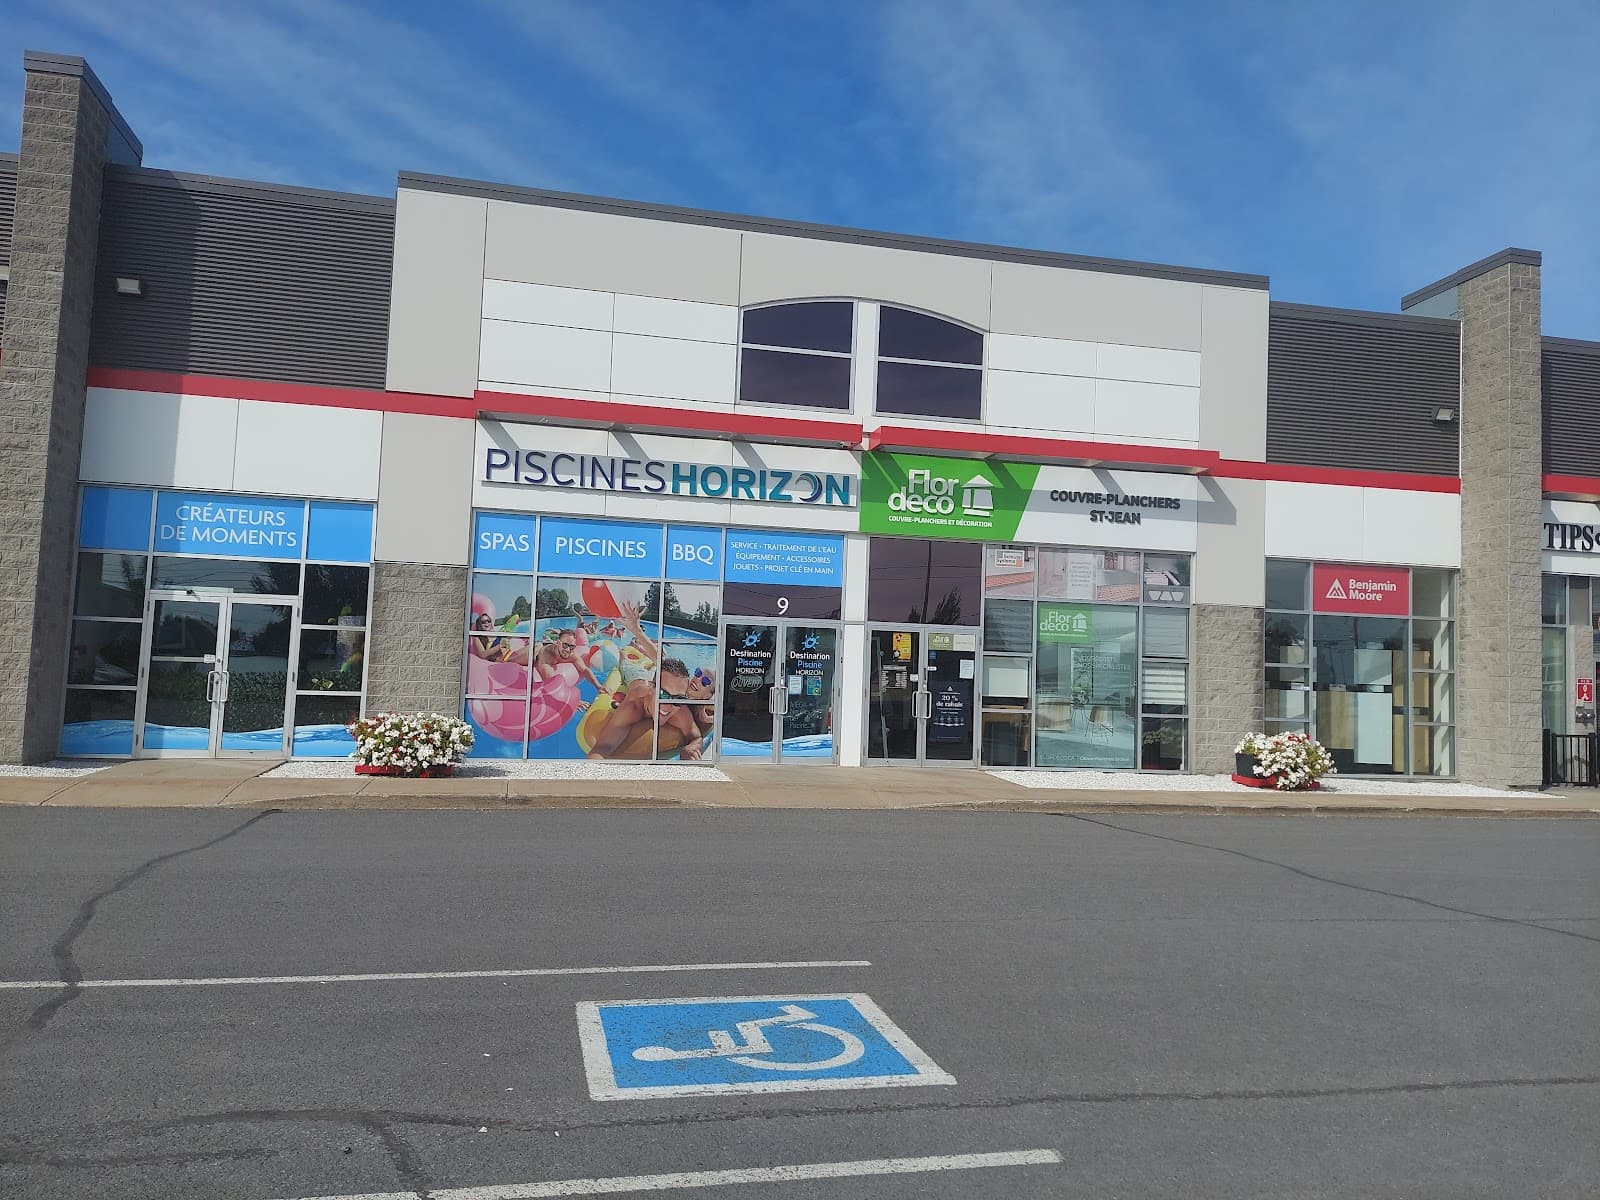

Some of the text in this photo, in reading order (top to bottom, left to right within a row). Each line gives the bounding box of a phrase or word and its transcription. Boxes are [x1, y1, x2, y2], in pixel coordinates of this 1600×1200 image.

[485, 447, 851, 505] PISCINES HORIZON
[908, 469, 959, 496] Flor
[887, 486, 955, 514] deco
[1050, 490, 1181, 509] COUVRE-PLANCHERS
[175, 502, 286, 527] CRÉATEURS
[1089, 509, 1141, 525] ST-JEAN
[160, 524, 297, 547] DE MOMENTS
[479, 532, 531, 552] SPAS
[1543, 522, 1600, 551] TIPS
[555, 537, 647, 559] PISCINES
[672, 543, 714, 565] BBQ
[731, 541, 758, 550] SERVICE
[763, 543, 806, 552] TRAITEMENT
[818, 546, 837, 554] L'EAU
[735, 551, 831, 564] ÉQUIPEMENT ACCESSOIRES
[733, 563, 759, 571] JOUETS
[764, 564, 788, 573] PROJET
[790, 565, 802, 573] CLÉ
[814, 567, 834, 575] MAIN
[1348, 579, 1397, 594] Benjamin
[1348, 590, 1383, 601] Moore
[777, 597, 789, 615] 9
[1048, 611, 1072, 623] Flor
[1039, 620, 1069, 632] deco
[730, 649, 771, 658] Destination
[790, 651, 830, 660] Destination
[737, 658, 763, 667] Piscine
[797, 660, 822, 669] Piscine
